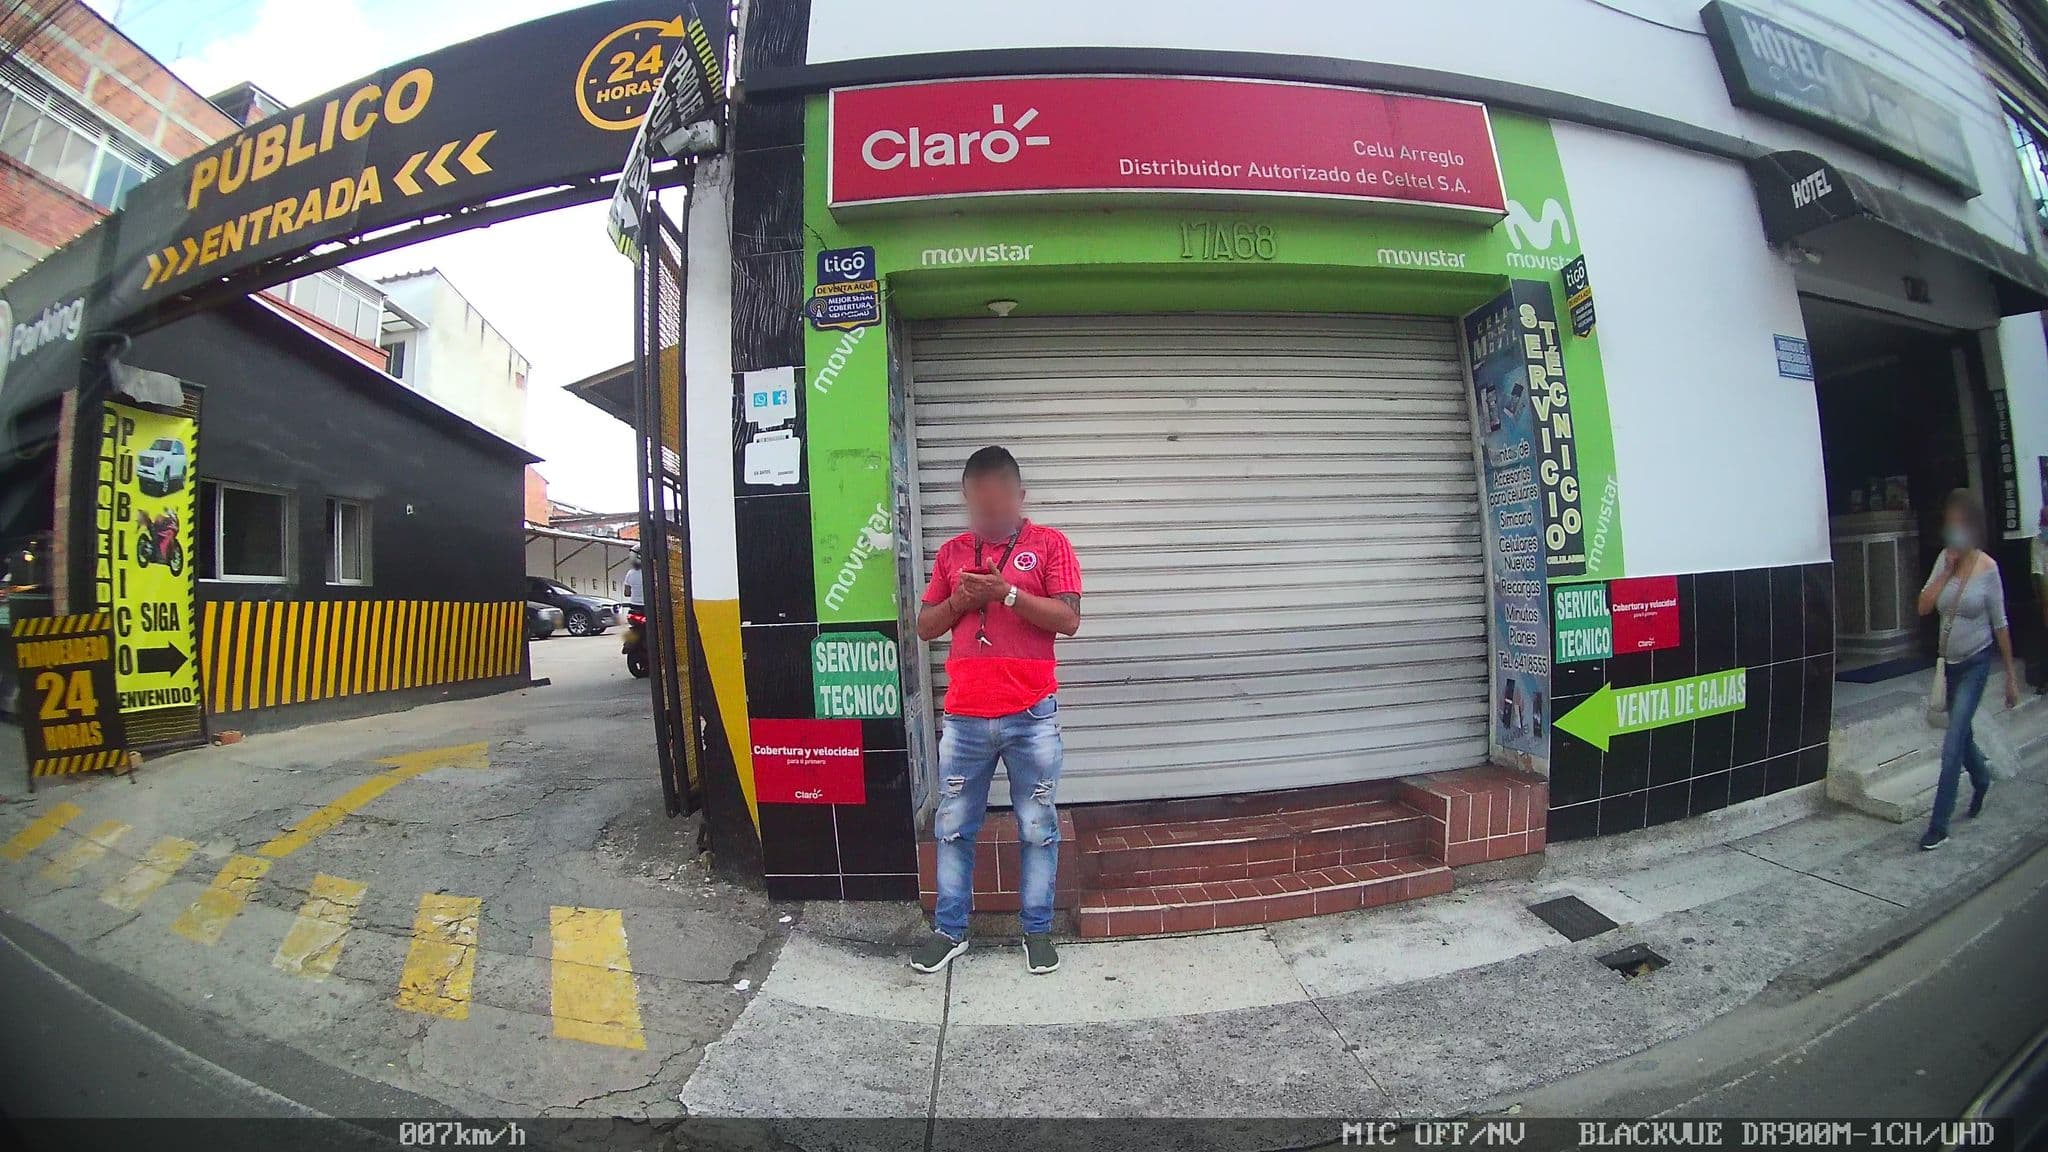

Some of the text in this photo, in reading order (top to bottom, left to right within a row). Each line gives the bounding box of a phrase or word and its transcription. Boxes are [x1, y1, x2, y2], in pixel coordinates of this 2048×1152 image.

[1741, 15, 1825, 81] HOTEL
[607, 44, 664, 84] 24
[596, 78, 662, 104] HORAS
[187, 68, 433, 210] PÚBLICO
[861, 126, 1020, 171] Claro
[1353, 140, 1465, 169] Celu Arreglo
[1119, 158, 1472, 195] Distribuidor Autorizado de Celtel S.A.
[1791, 168, 1832, 209] HOTEL
[199, 165, 383, 266] ENTRADA
[921, 243, 1034, 266] movistar
[1180, 220, 1279, 261] 17A68
[1376, 247, 1466, 270] movistar
[1506, 252, 1570, 271] movist
[817, 286, 827, 295] DE
[828, 284, 853, 293] VENTA
[828, 295, 851, 305] MEJOR
[828, 302, 873, 313] COBERTURA
[11, 297, 85, 362] Parking
[814, 326, 866, 394] movis
[1519, 303, 1566, 551] SERVICIO
[1518, 439, 1530, 459] de
[1493, 466, 1532, 488] Accesorios
[96, 412, 117, 613] PARQUEAD
[1588, 475, 1616, 572] movistar
[117, 417, 135, 677] PÚBLICO
[1499, 532, 1538, 554] Celulares
[1503, 555, 1536, 571] Nuevos
[1501, 577, 1541, 599] Recargas
[140, 602, 181, 633] SIGA
[1505, 604, 1538, 623] Minutos
[1508, 627, 1537, 647] Planes
[1558, 626, 1610, 658] TECNICO
[815, 640, 898, 673] SERVICIO
[36, 669, 99, 720] 24
[119, 686, 192, 709] ENVENIDO
[819, 684, 897, 716] TECNICO
[1616, 673, 1746, 729] VENTA DE CAJAS
[43, 720, 104, 751] HORAS
[753, 745, 860, 758] Cobertura y velocidad
[795, 790, 819, 800] Claro
